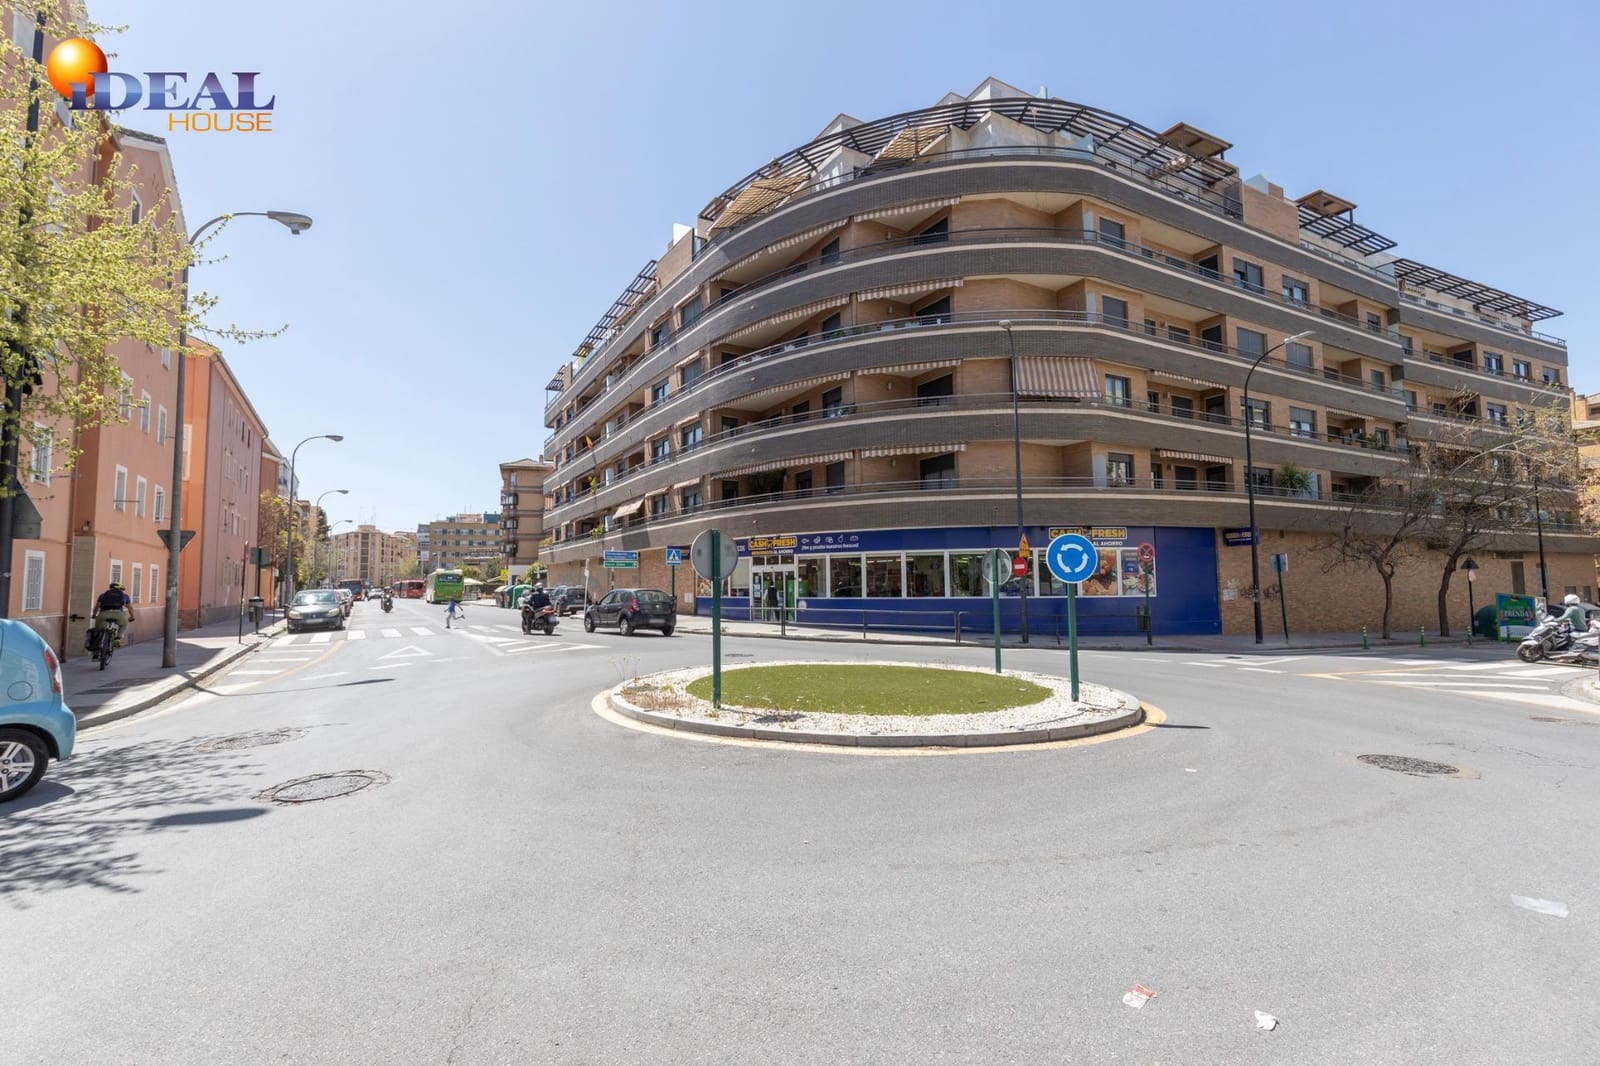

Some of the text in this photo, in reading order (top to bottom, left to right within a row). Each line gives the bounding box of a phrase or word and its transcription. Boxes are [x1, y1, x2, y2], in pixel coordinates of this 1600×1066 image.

[1051, 529, 1125, 538] CASH FRESH
[750, 538, 795, 548] CASH FRESH
